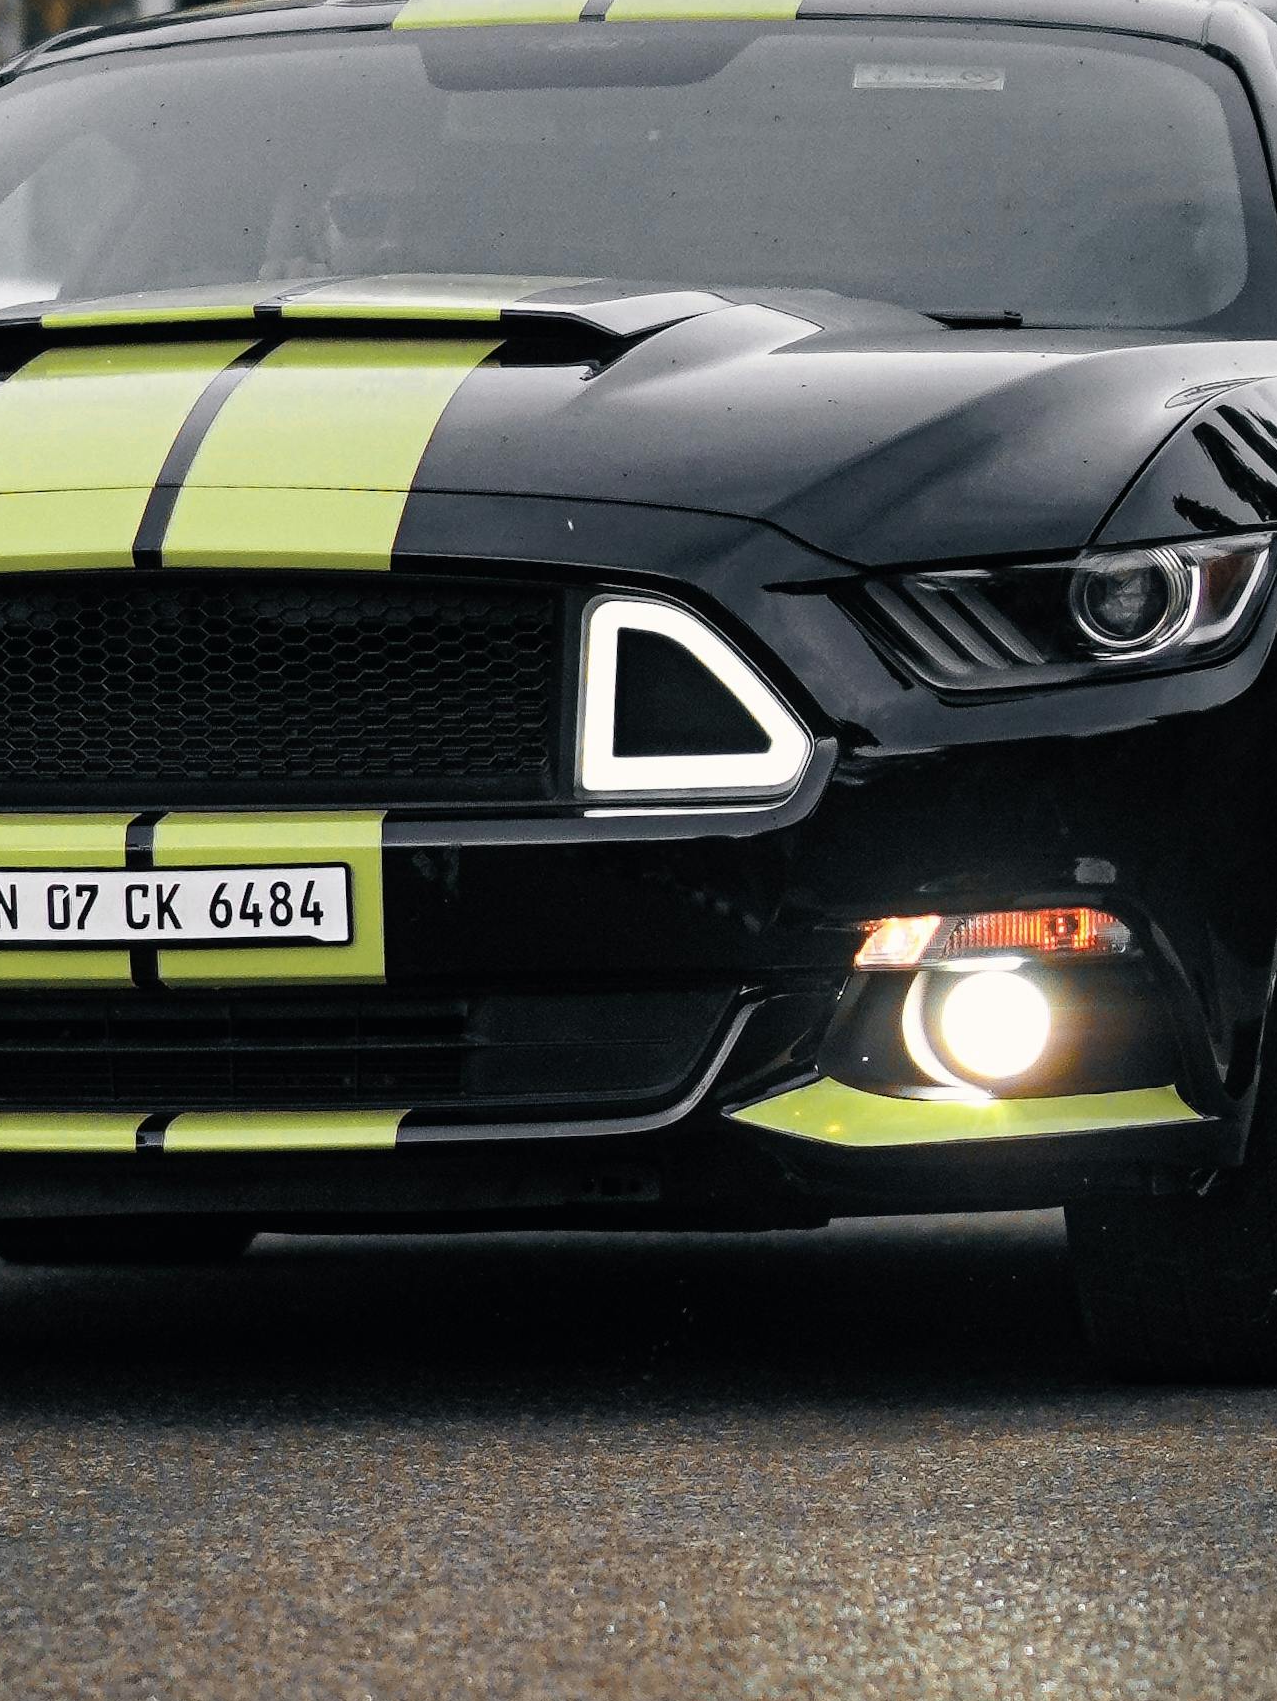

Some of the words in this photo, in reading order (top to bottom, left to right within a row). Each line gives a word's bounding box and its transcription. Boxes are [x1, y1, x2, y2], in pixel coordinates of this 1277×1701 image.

[47, 884, 99, 931] 07
[125, 883, 183, 930] CK
[209, 881, 324, 929] 6484
